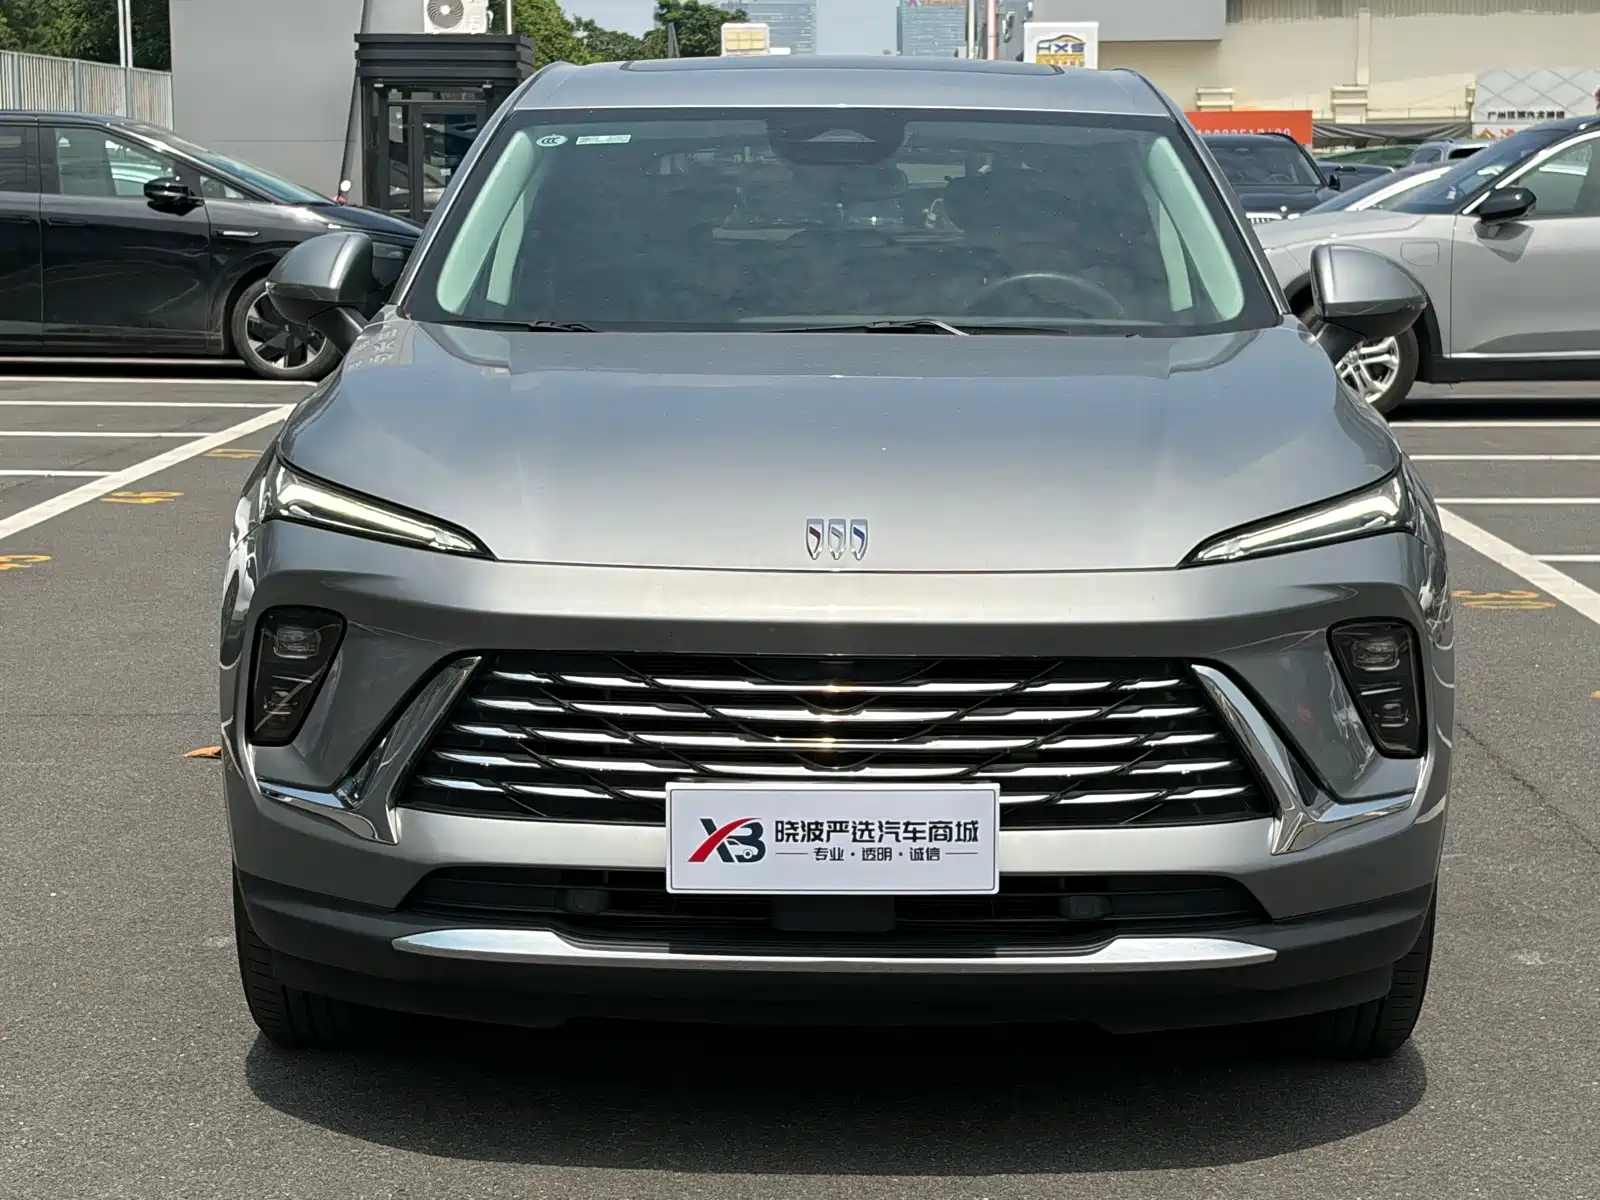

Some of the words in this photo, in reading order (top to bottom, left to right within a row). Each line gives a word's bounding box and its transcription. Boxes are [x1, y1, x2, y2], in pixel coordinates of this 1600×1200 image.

[687, 817, 766, 863] XB
[774, 820, 979, 842] 晓波严选汽车商城
